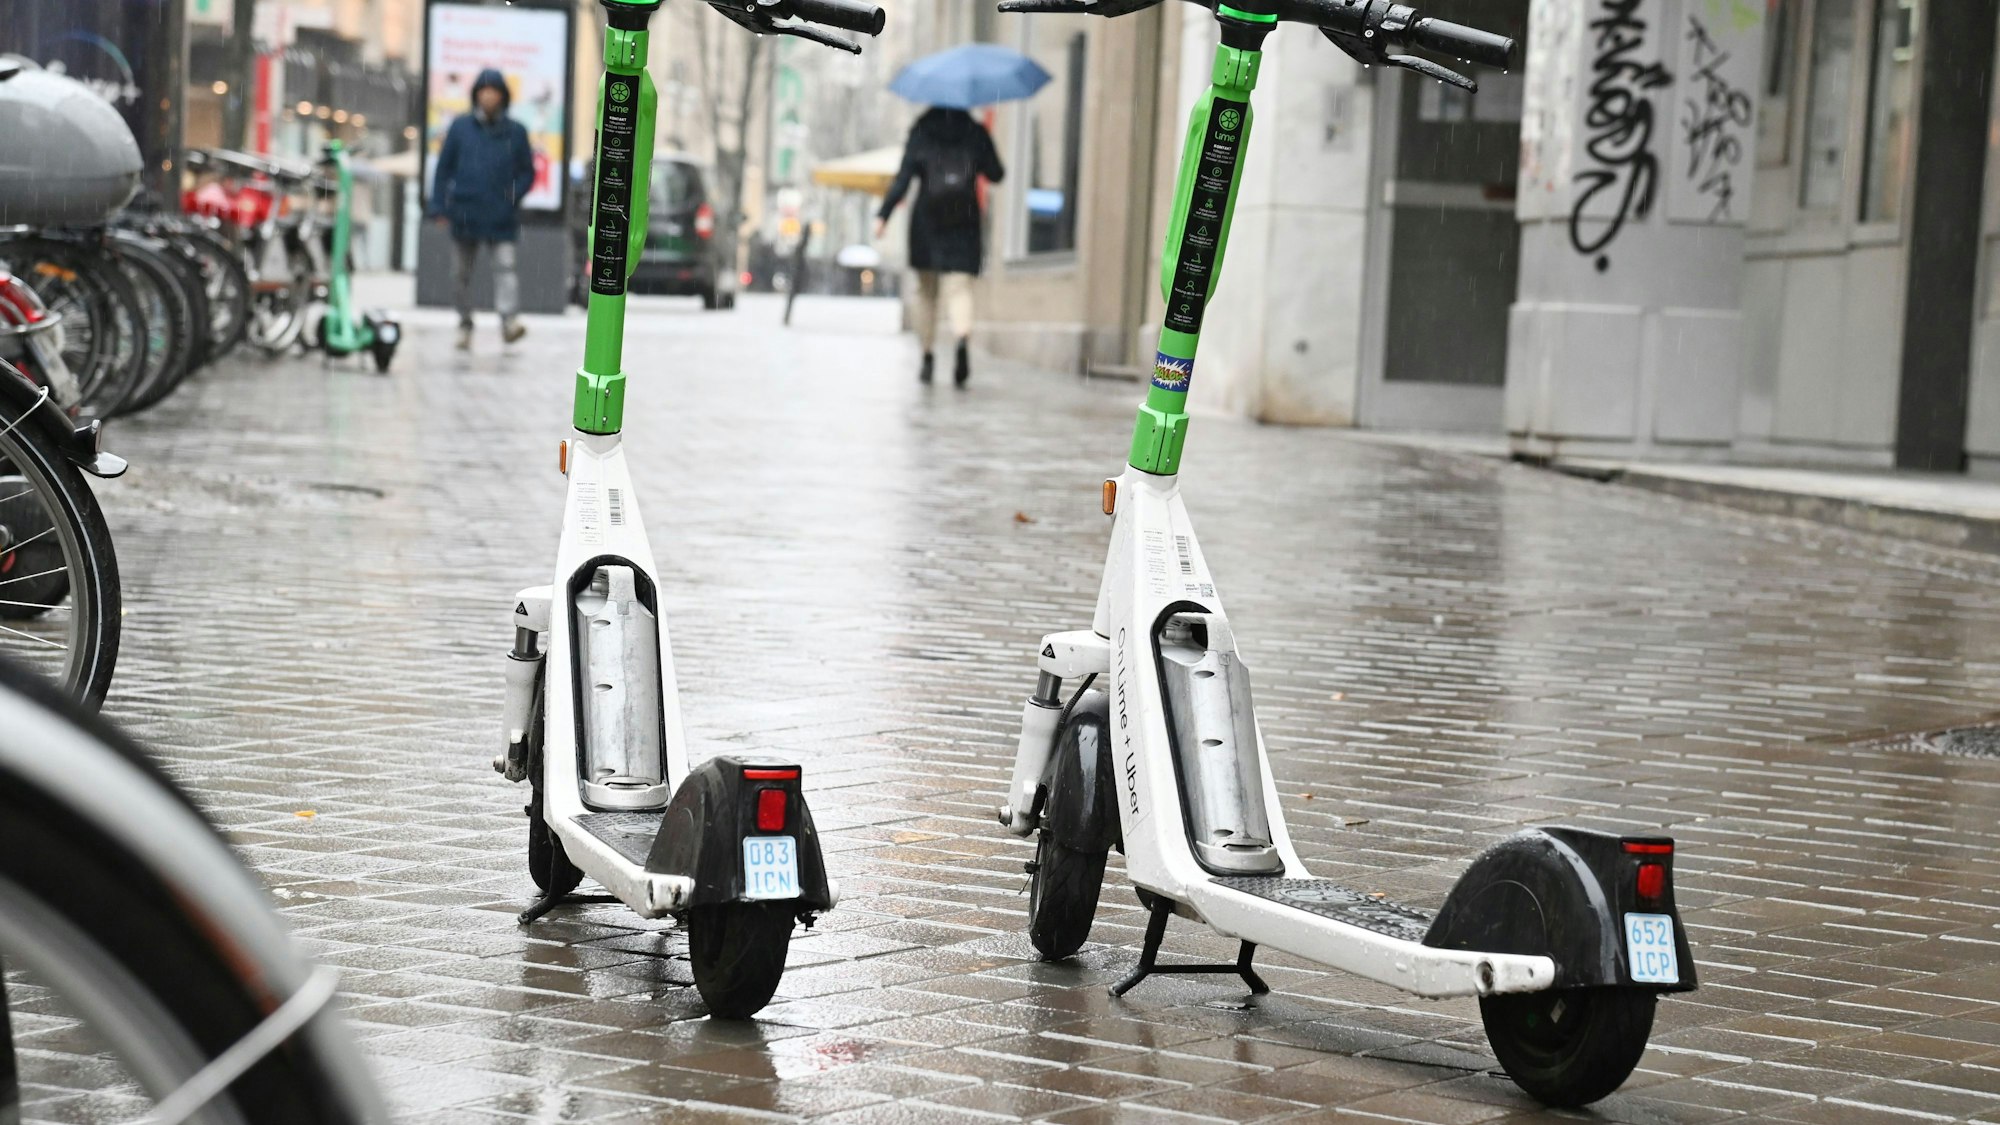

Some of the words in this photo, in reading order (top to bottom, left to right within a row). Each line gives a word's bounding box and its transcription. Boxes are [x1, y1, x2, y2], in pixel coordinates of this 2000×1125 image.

[608, 103, 629, 114] Lime
[1214, 131, 1236, 142] Lime
[1117, 627, 1127, 666] On
[1117, 667, 1129, 730] Lime
[1125, 752, 1140, 815] Uber
[750, 842, 789, 866] 083
[1632, 920, 1668, 945] 652
